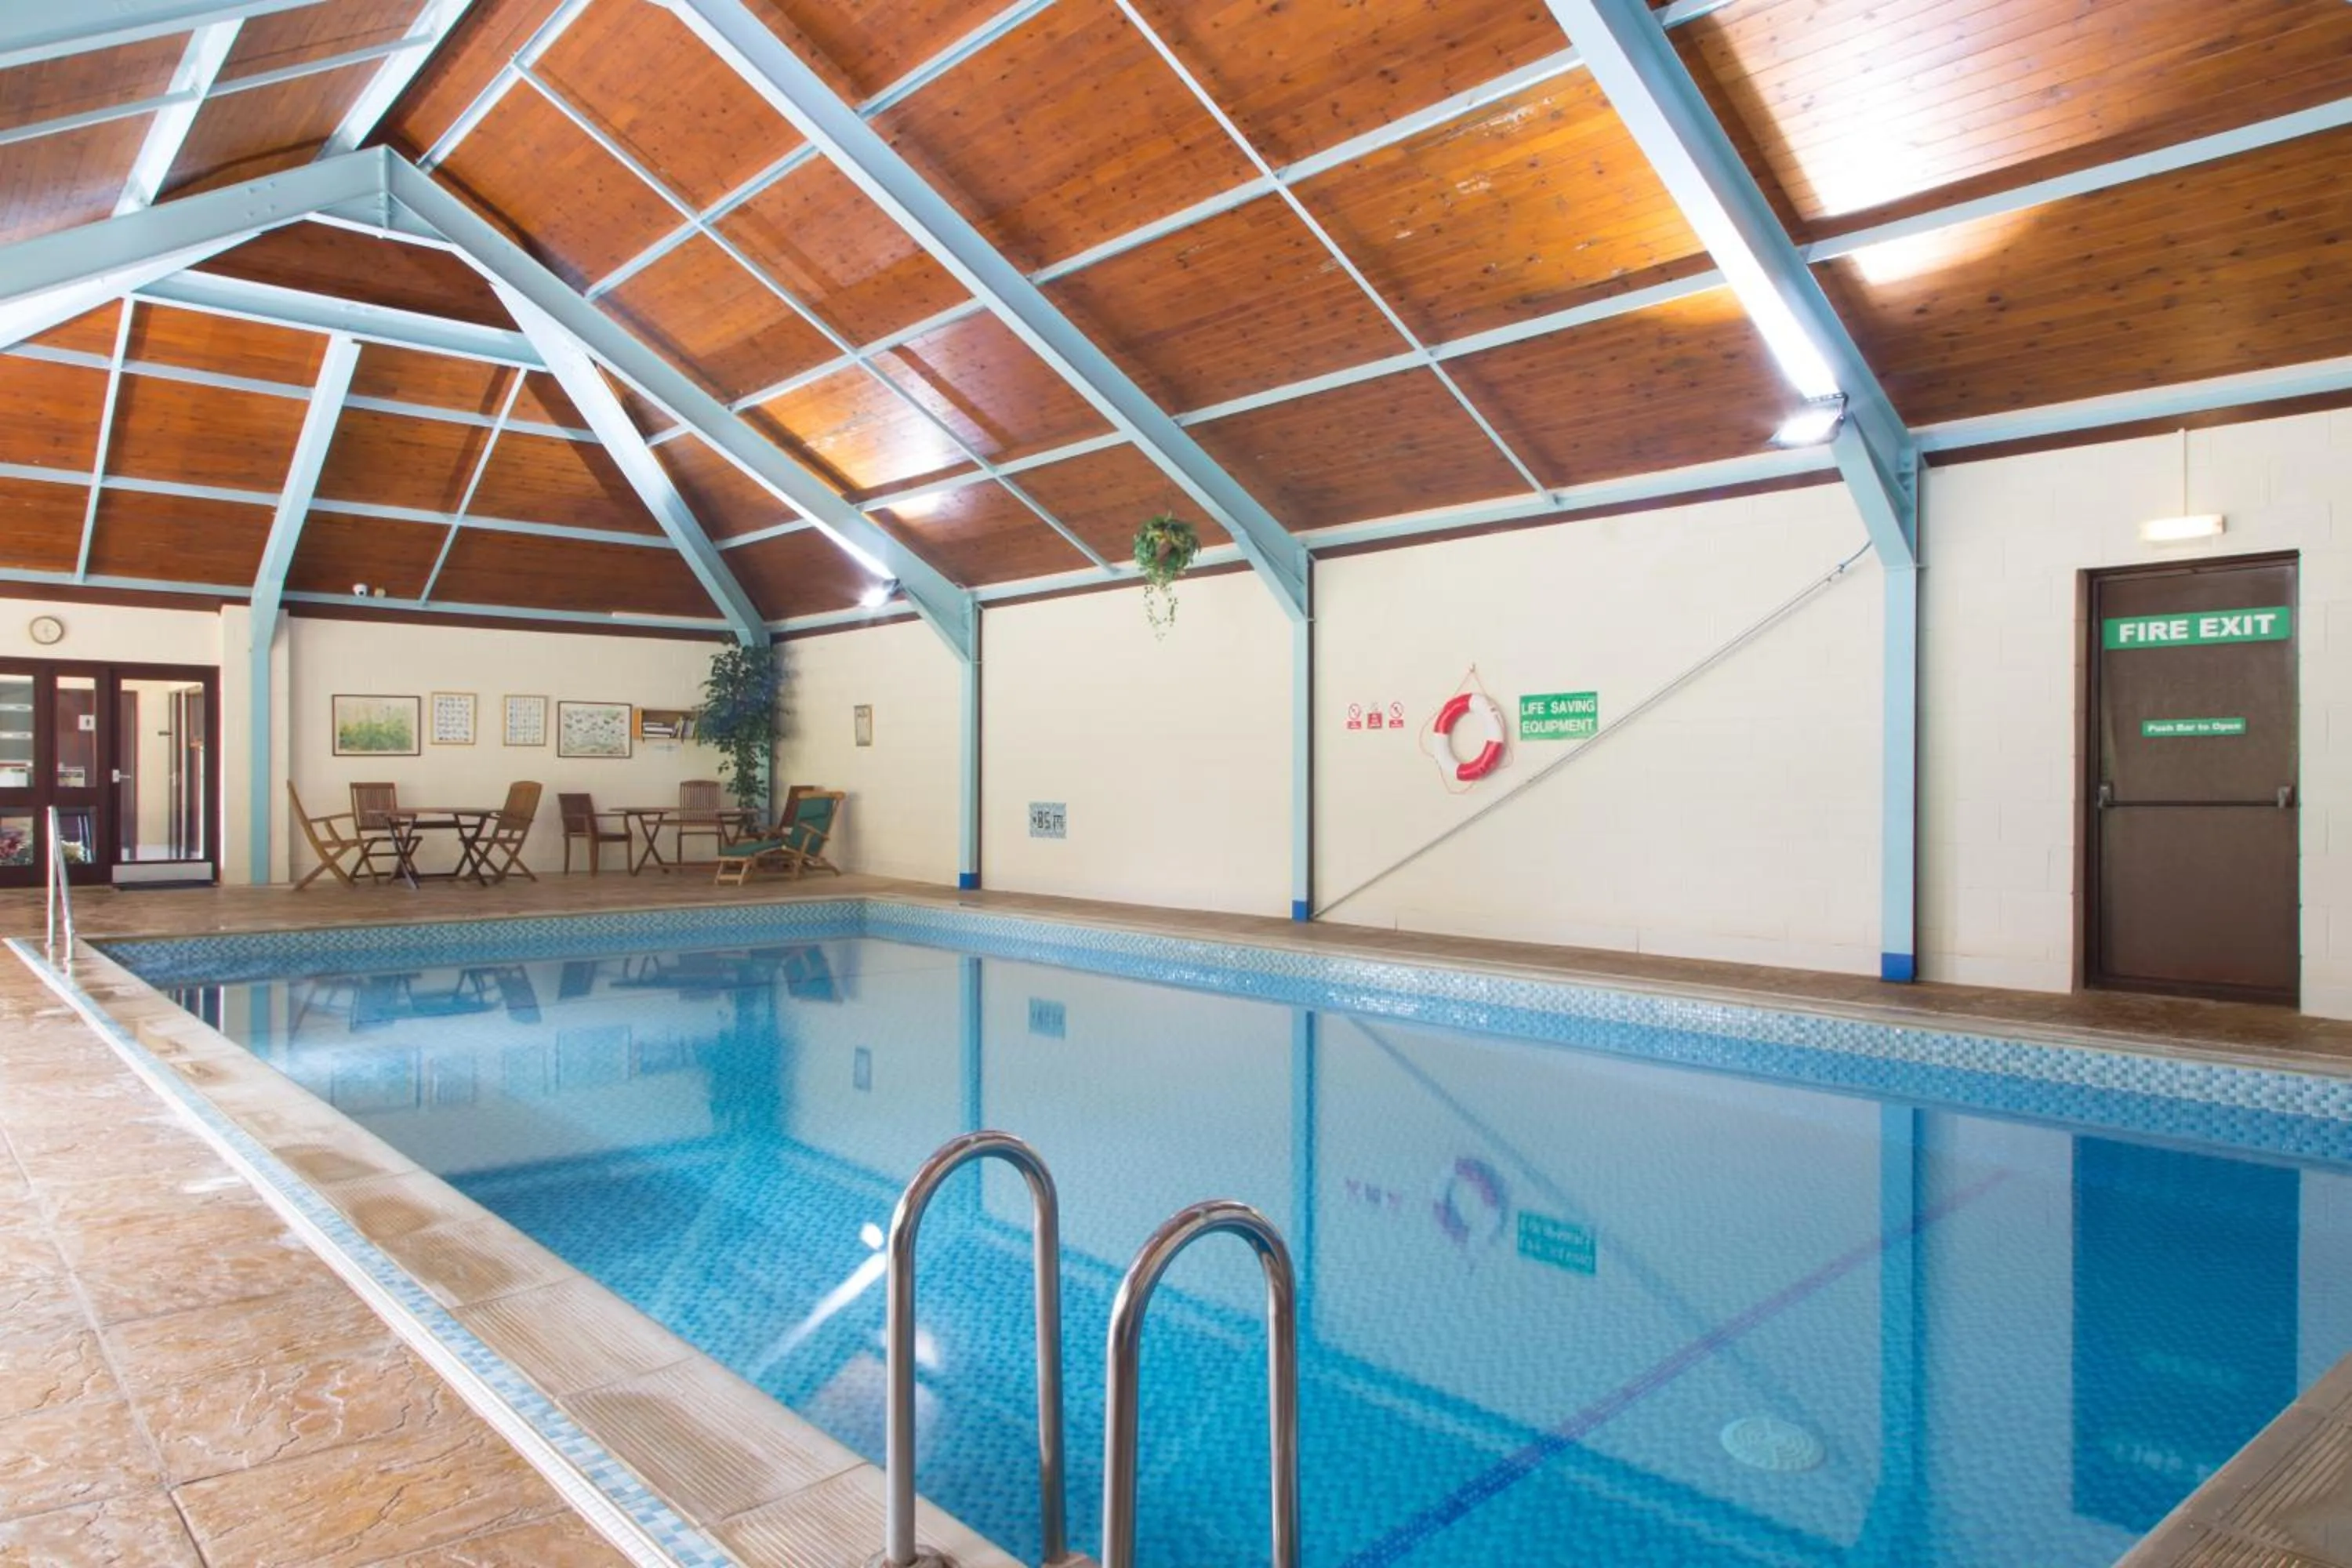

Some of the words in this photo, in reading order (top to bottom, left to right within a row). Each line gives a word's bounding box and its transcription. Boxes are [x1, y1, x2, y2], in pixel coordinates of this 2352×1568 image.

[2119, 619, 2189, 643] FIRE
[2199, 614, 2277, 638] EXIT
[1522, 702, 1544, 715] LIFE
[1550, 700, 1595, 714] SAVING
[1522, 719, 1594, 733] EQUIPMENT
[2147, 723, 2174, 732] Push
[2176, 723, 2195, 731] Bar
[2212, 721, 2241, 732] Open
